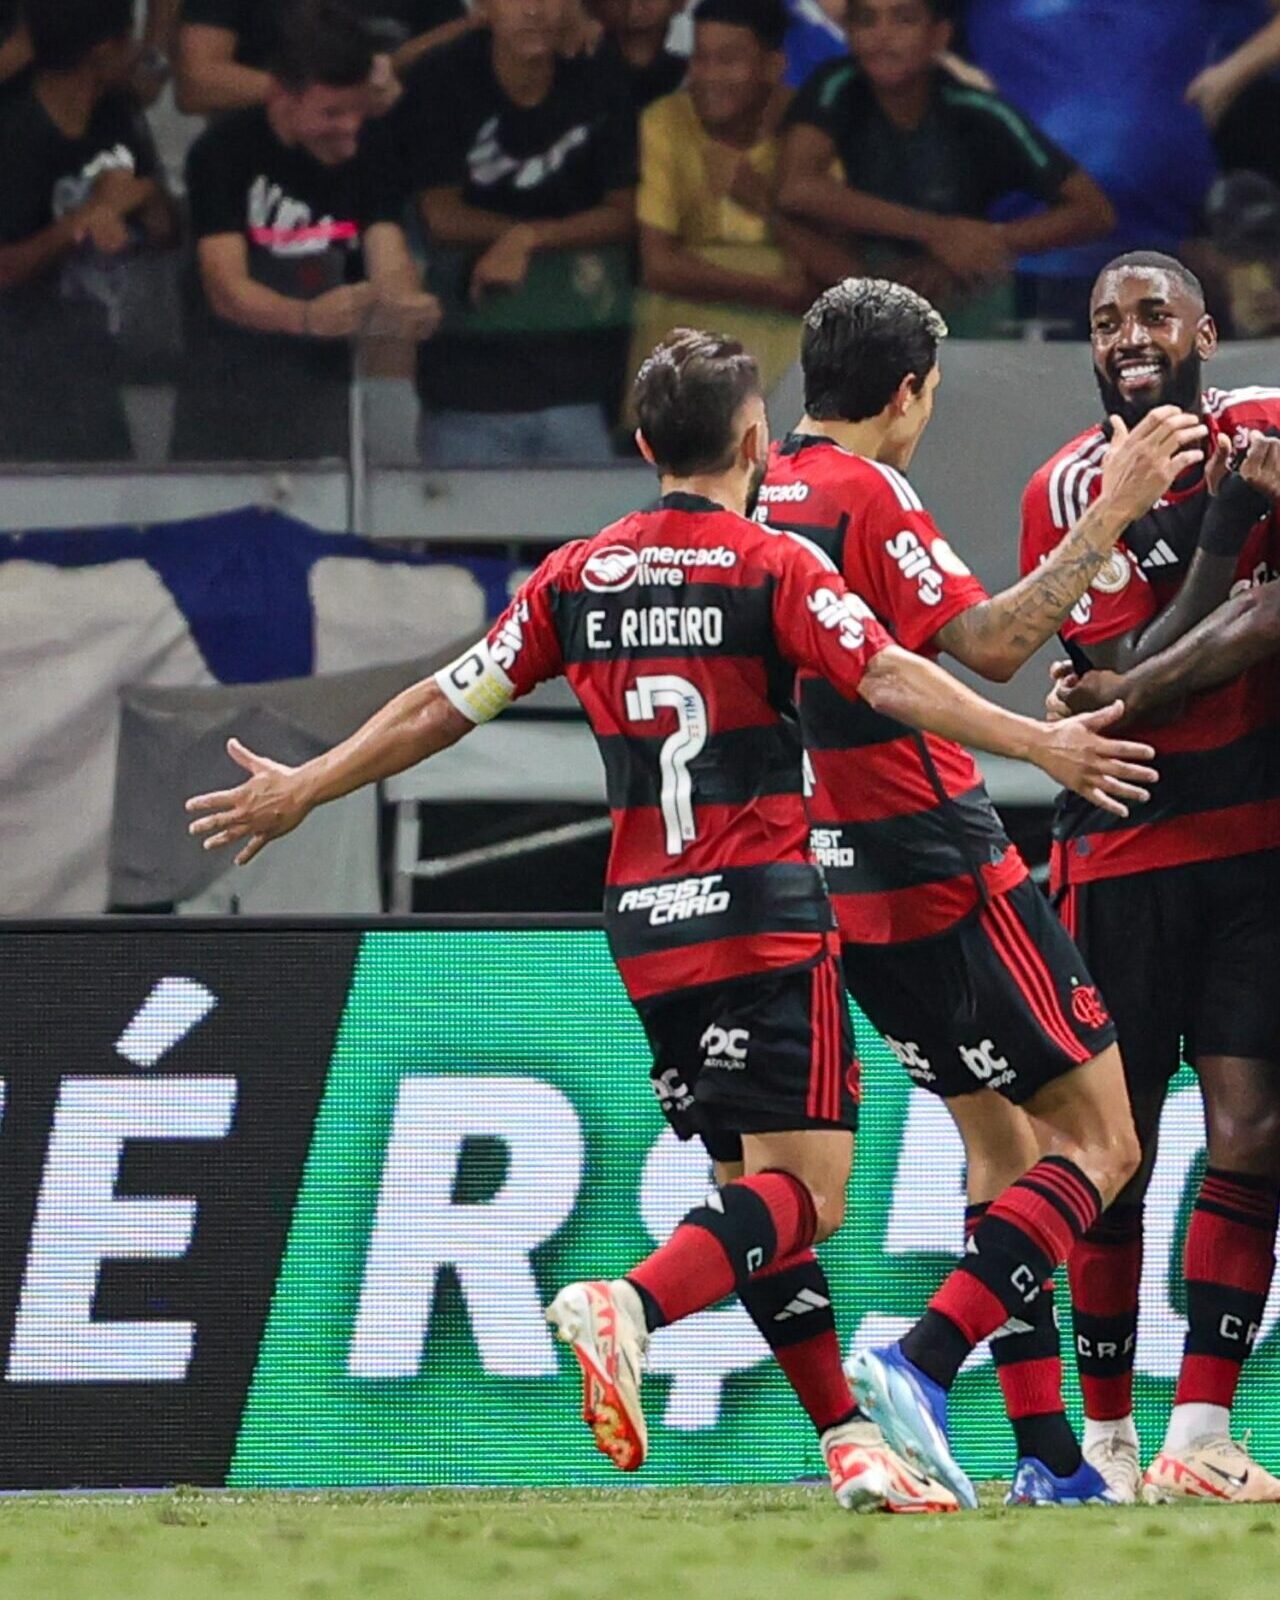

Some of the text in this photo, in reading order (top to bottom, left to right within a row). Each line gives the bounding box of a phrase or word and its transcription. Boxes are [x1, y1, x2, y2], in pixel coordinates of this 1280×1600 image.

[638, 546, 736, 568] mercado
[637, 566, 684, 587] livre
[586, 606, 723, 649] E. RIBEIRO
[450, 653, 485, 691] C
[625, 674, 707, 855] 7
[618, 874, 723, 913] ASSIST
[648, 890, 731, 927] CARD
[4, 976, 239, 1382] É
